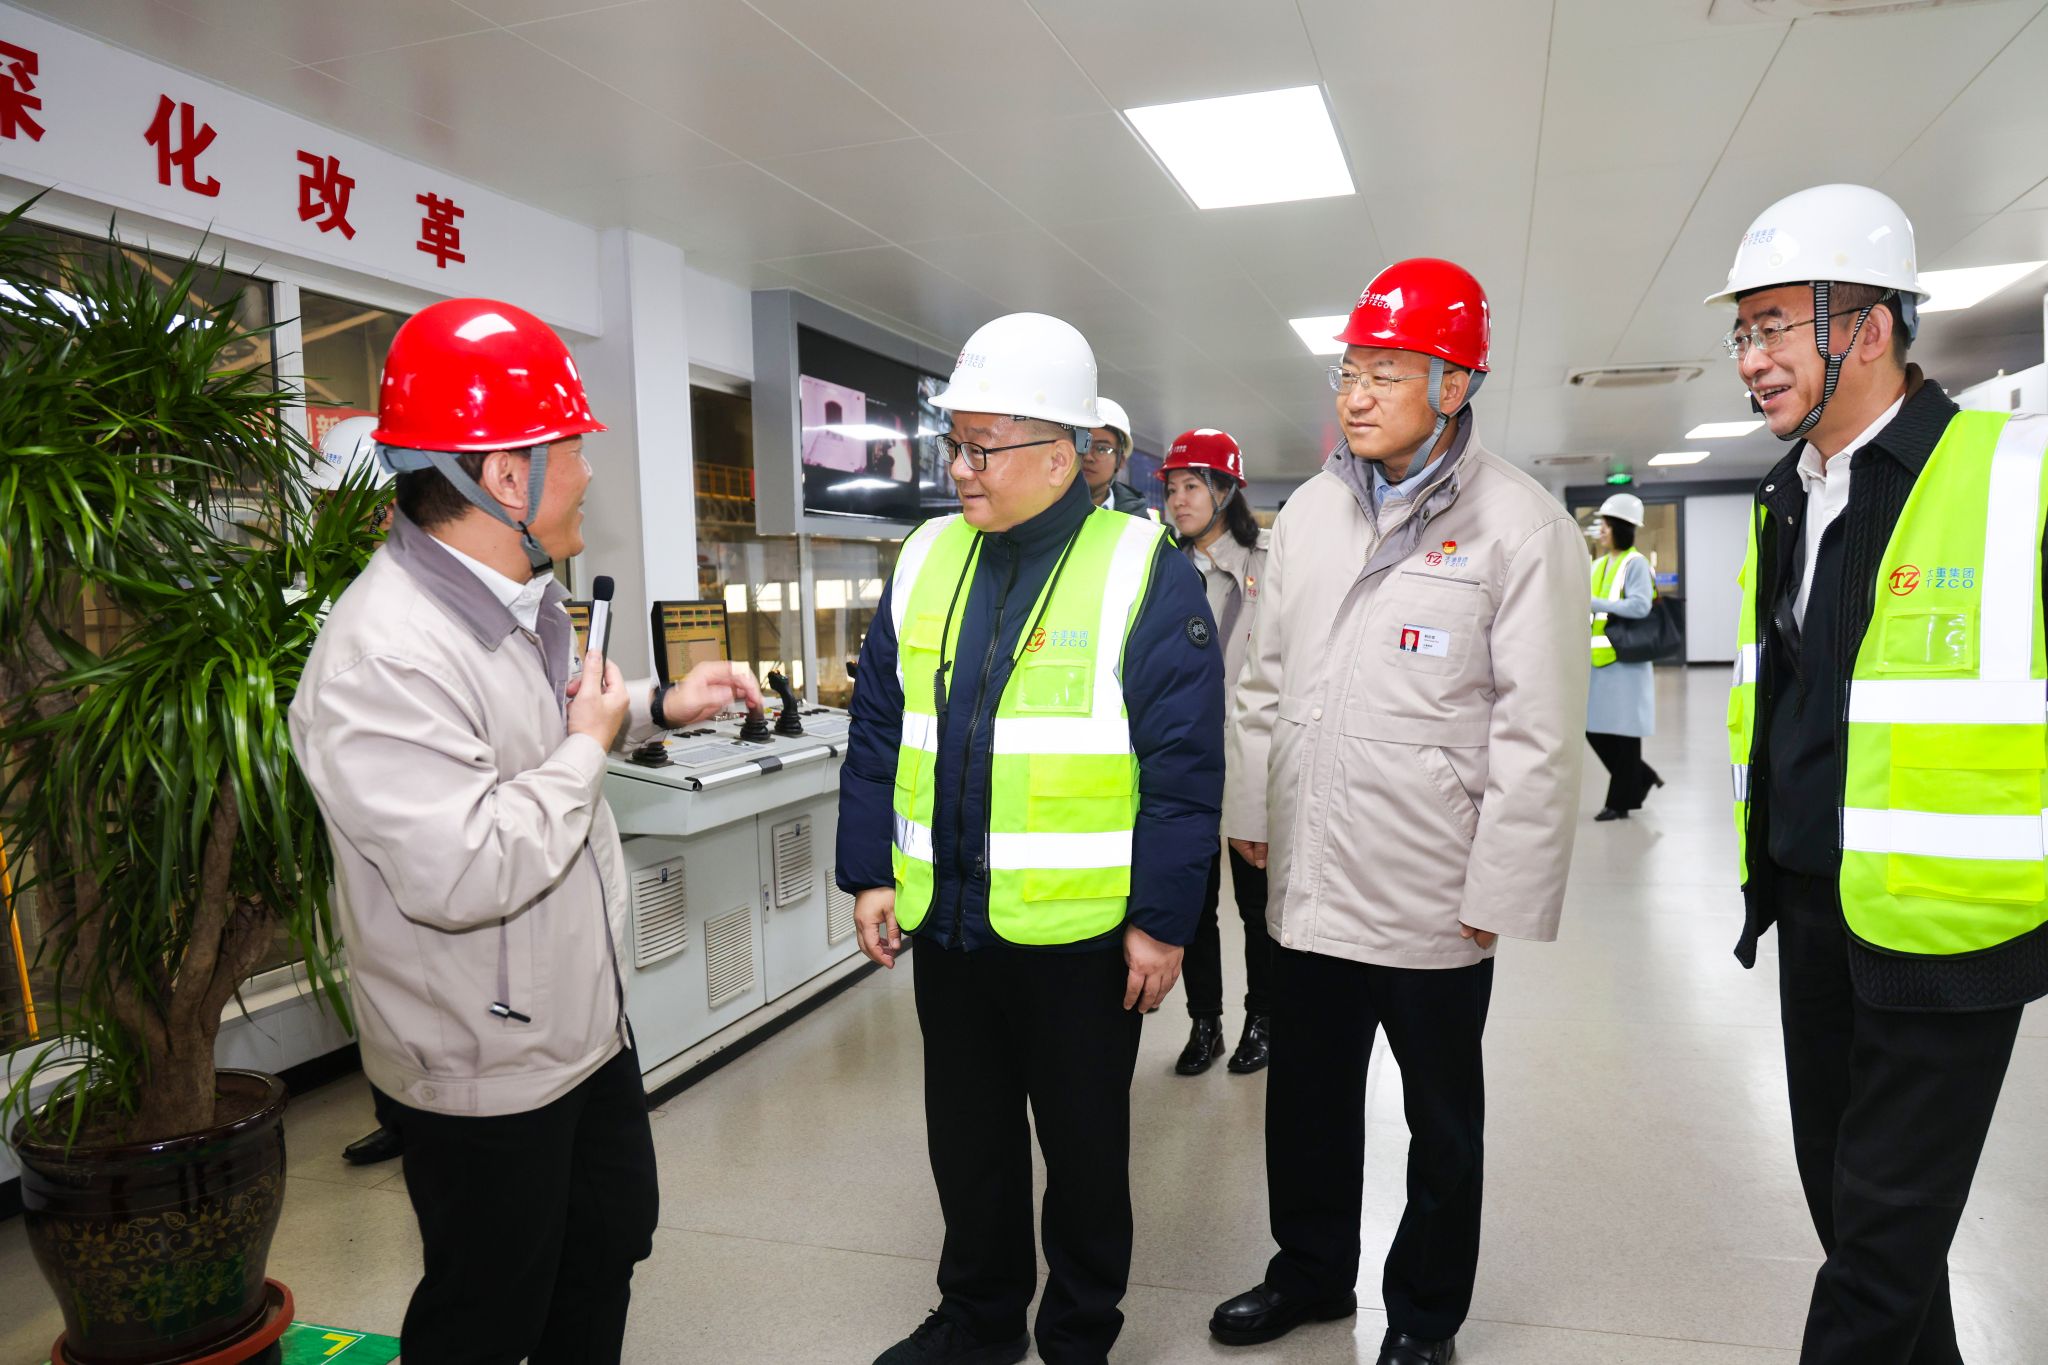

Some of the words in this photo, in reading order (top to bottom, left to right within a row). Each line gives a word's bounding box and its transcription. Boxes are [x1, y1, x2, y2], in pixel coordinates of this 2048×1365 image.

[1426, 553, 1442, 566] TZ
[1889, 568, 1920, 592] TZ
[1926, 578, 1974, 589] TZCO
[1050, 638, 1088, 648] TZCO
